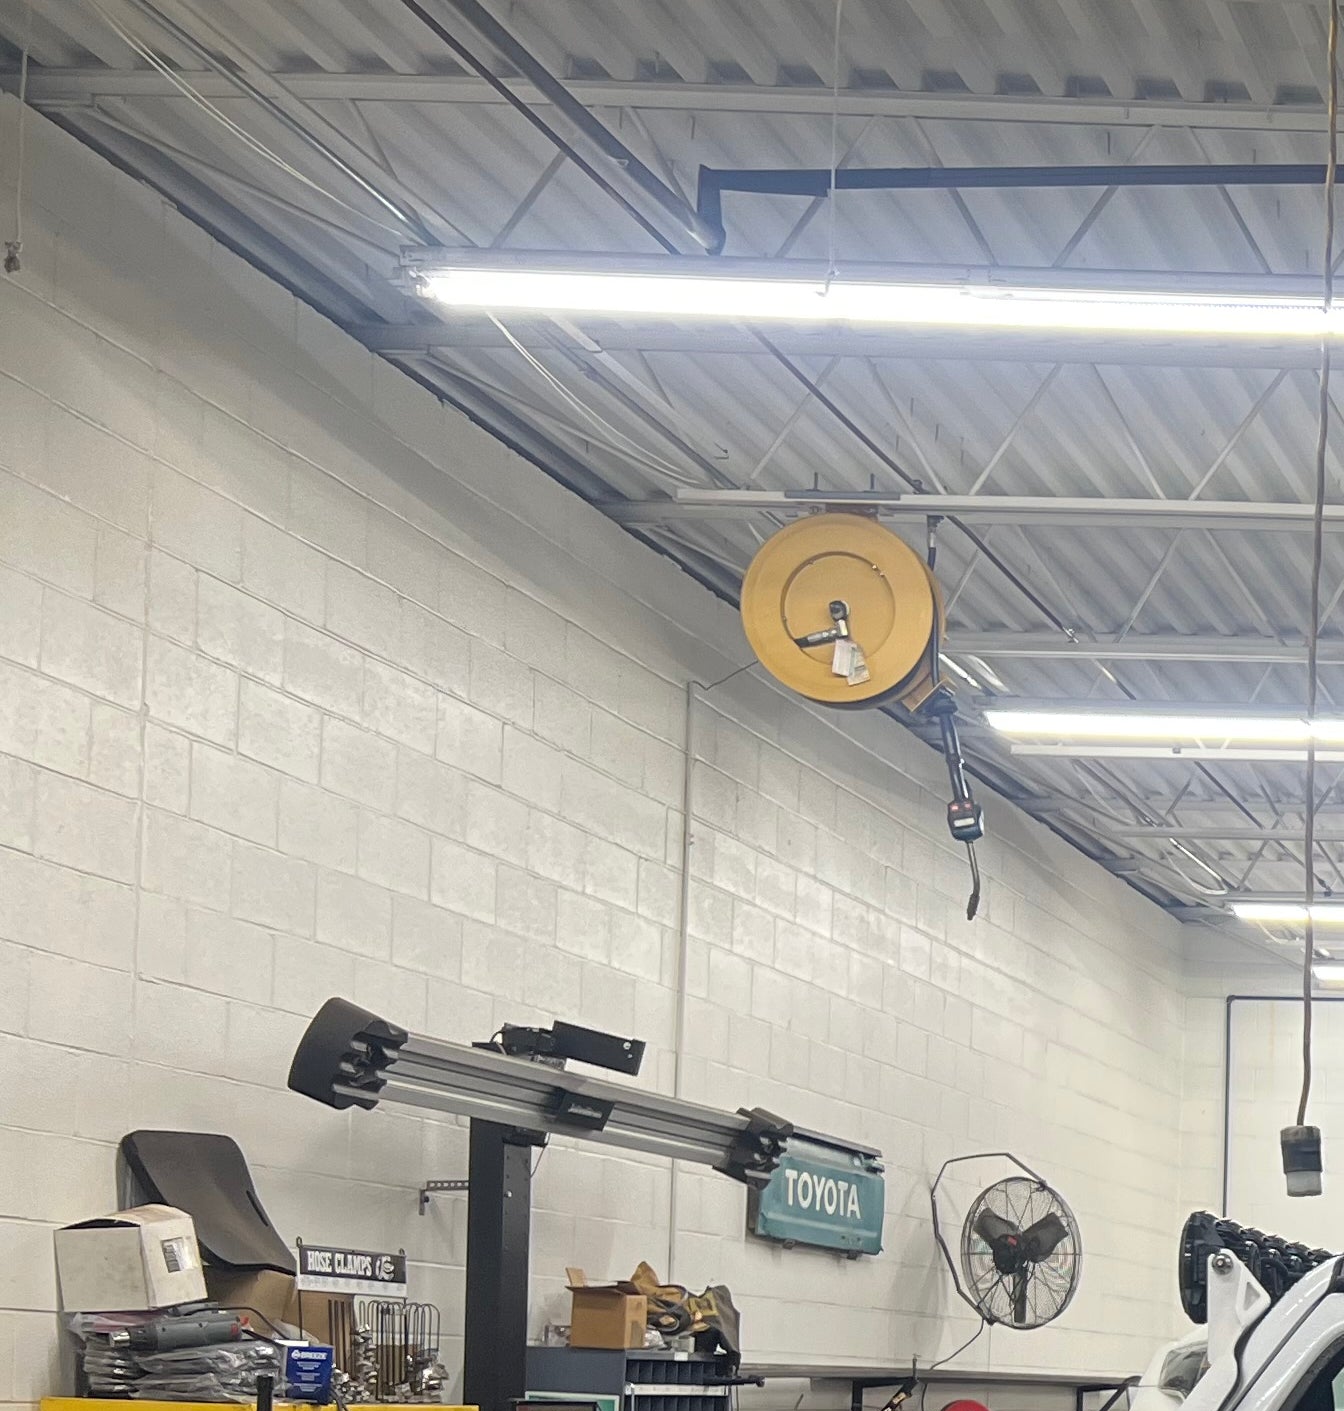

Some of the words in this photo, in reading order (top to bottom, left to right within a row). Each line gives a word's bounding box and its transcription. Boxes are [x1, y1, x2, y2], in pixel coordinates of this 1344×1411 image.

[785, 1169, 861, 1219] TOYOTA
[307, 1250, 332, 1272] HOSE
[334, 1253, 372, 1277] CLAMPS
